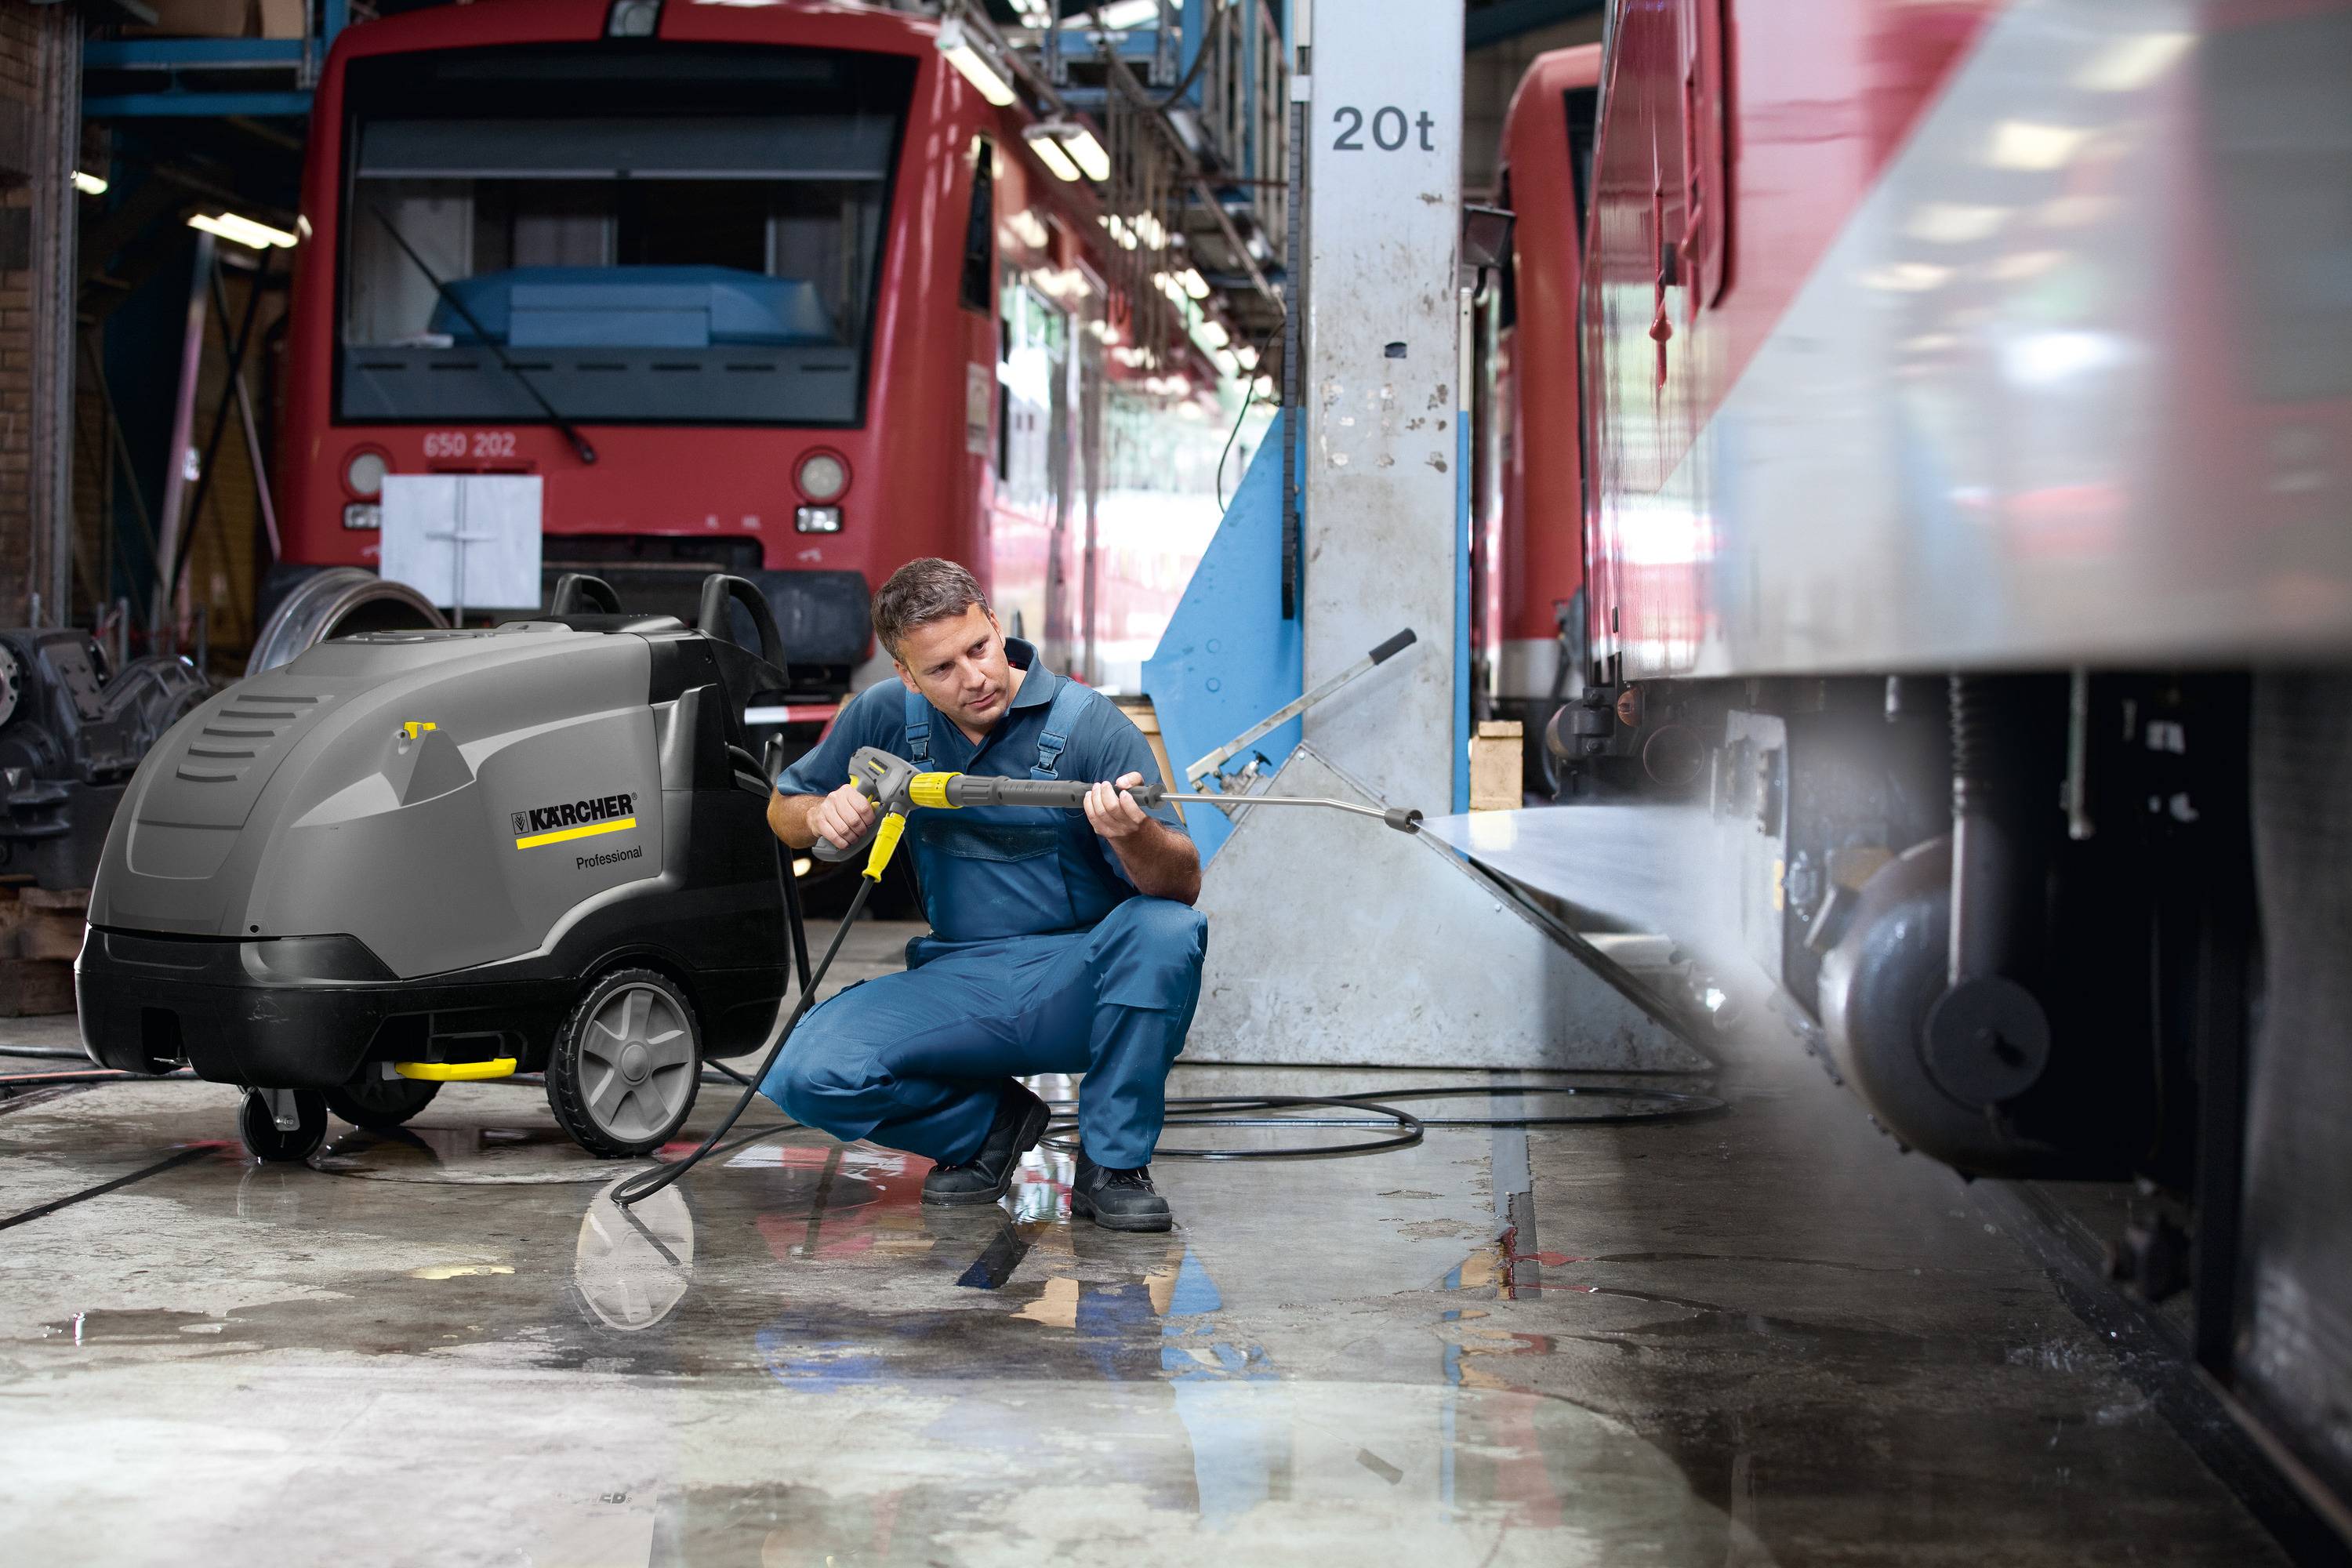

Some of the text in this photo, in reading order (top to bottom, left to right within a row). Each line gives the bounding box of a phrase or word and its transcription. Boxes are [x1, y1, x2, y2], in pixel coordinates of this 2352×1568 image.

[423, 432, 517, 459] 650 202
[576, 845, 643, 870] Professional
